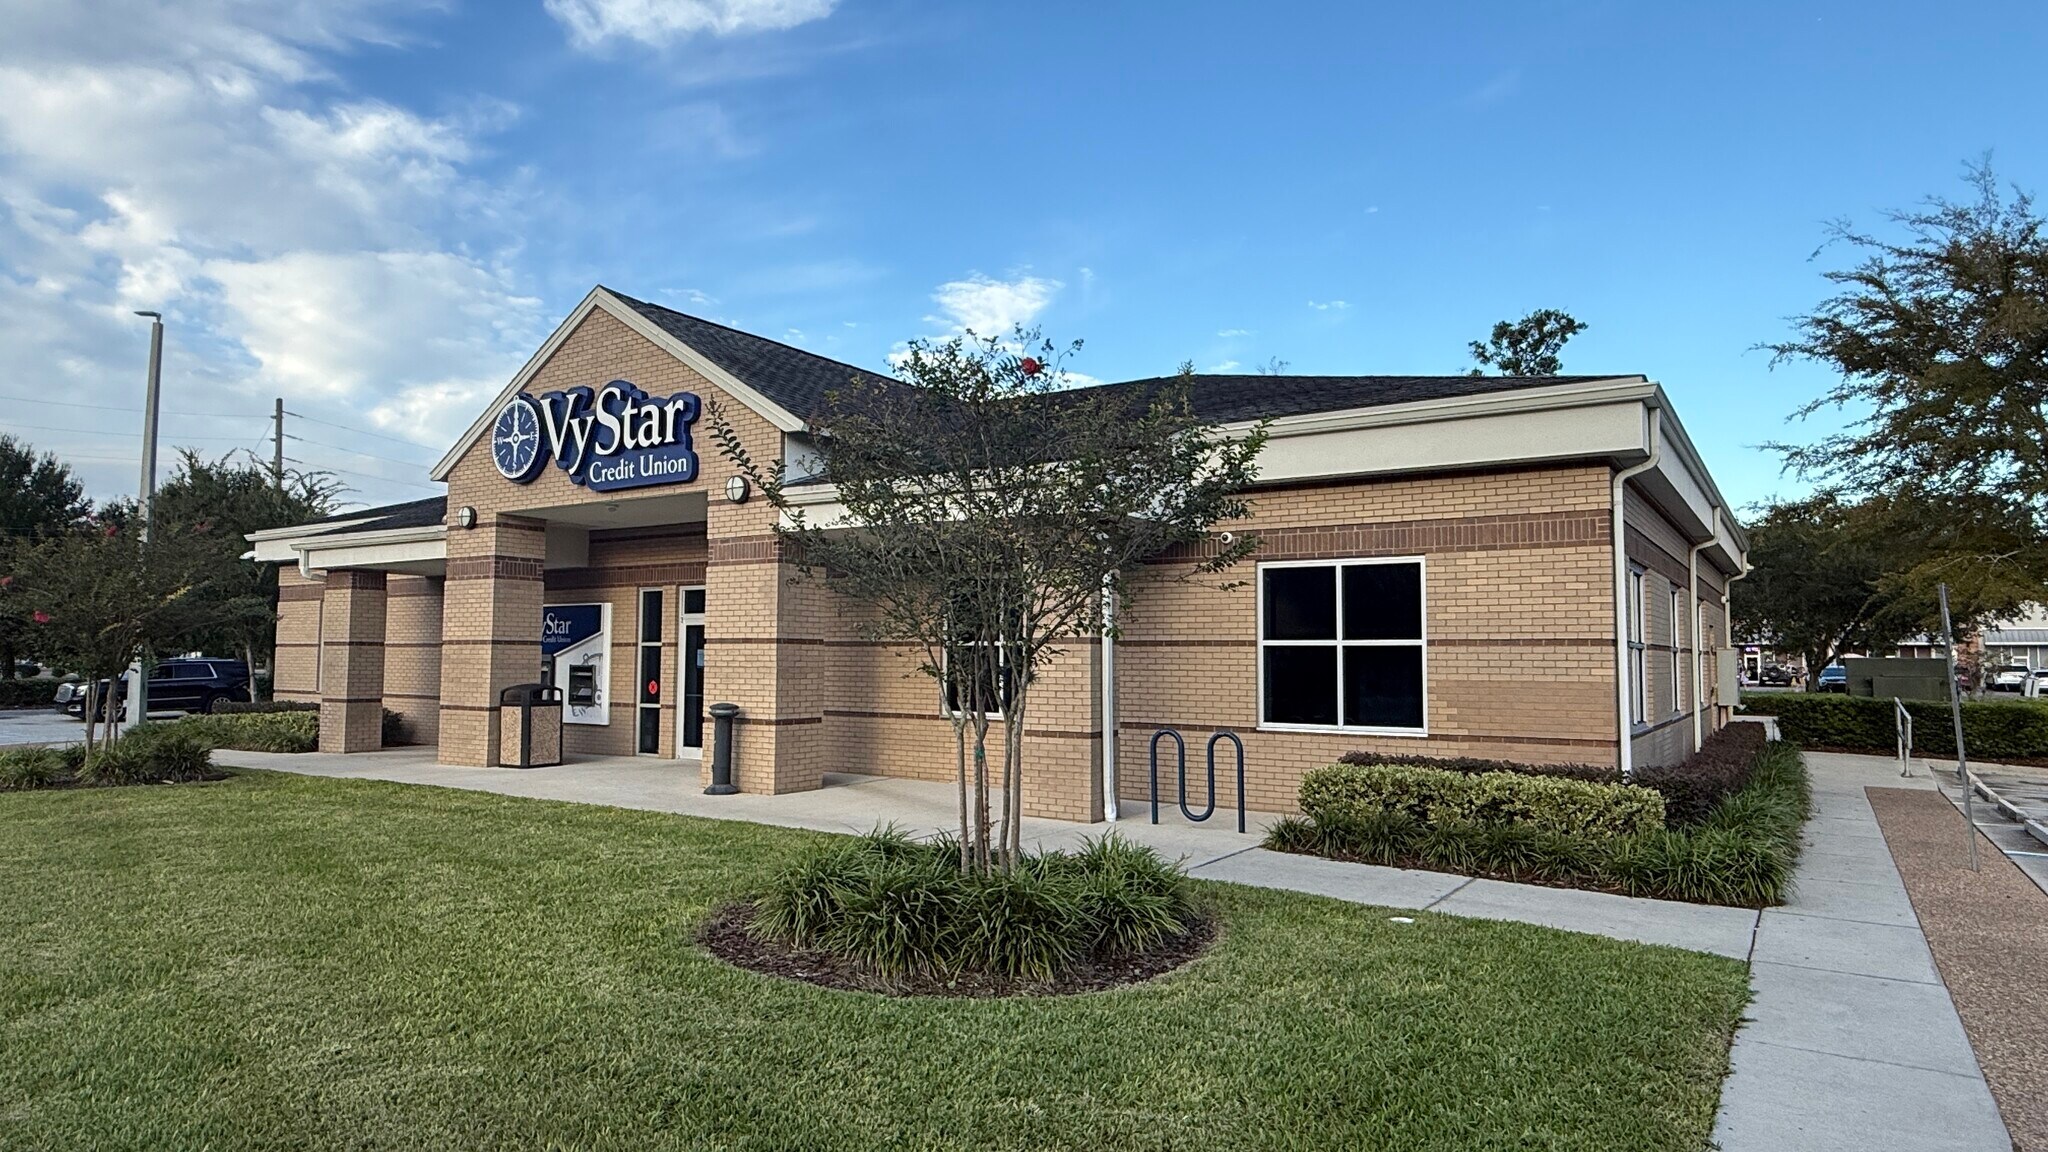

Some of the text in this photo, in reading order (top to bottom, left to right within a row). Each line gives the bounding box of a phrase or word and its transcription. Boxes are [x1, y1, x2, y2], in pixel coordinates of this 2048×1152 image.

[540, 387, 684, 476] VyStar
[589, 454, 687, 483] Credit Union
